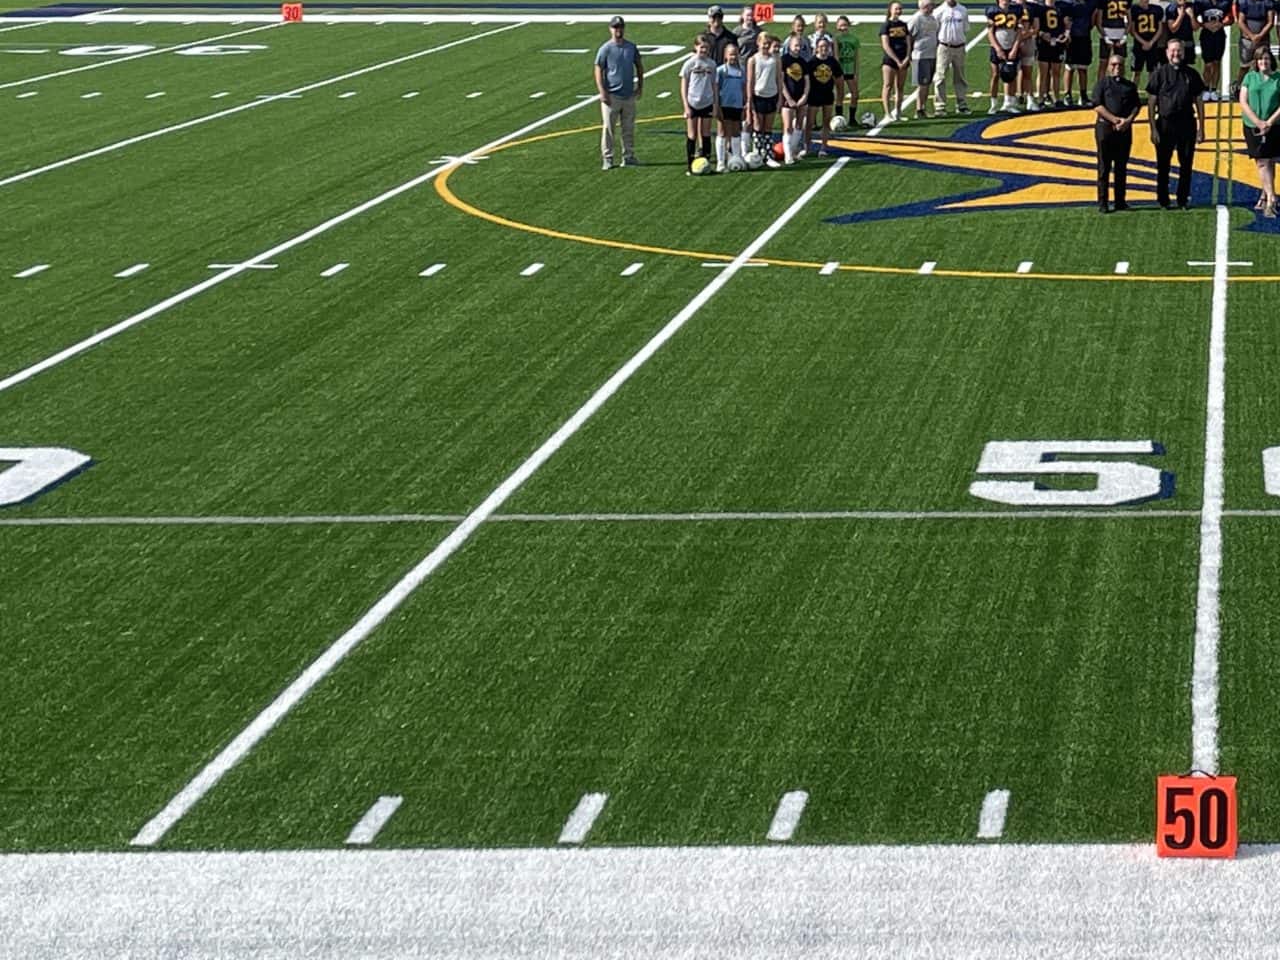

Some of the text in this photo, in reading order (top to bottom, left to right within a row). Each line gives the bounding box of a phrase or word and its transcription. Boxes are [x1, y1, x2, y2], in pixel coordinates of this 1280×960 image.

[284, 6, 299, 20] 30
[756, 6, 771, 20] 40
[1046, 9, 1059, 29] 6
[1138, 13, 1157, 33] 21
[1164, 787, 1228, 850] 50
